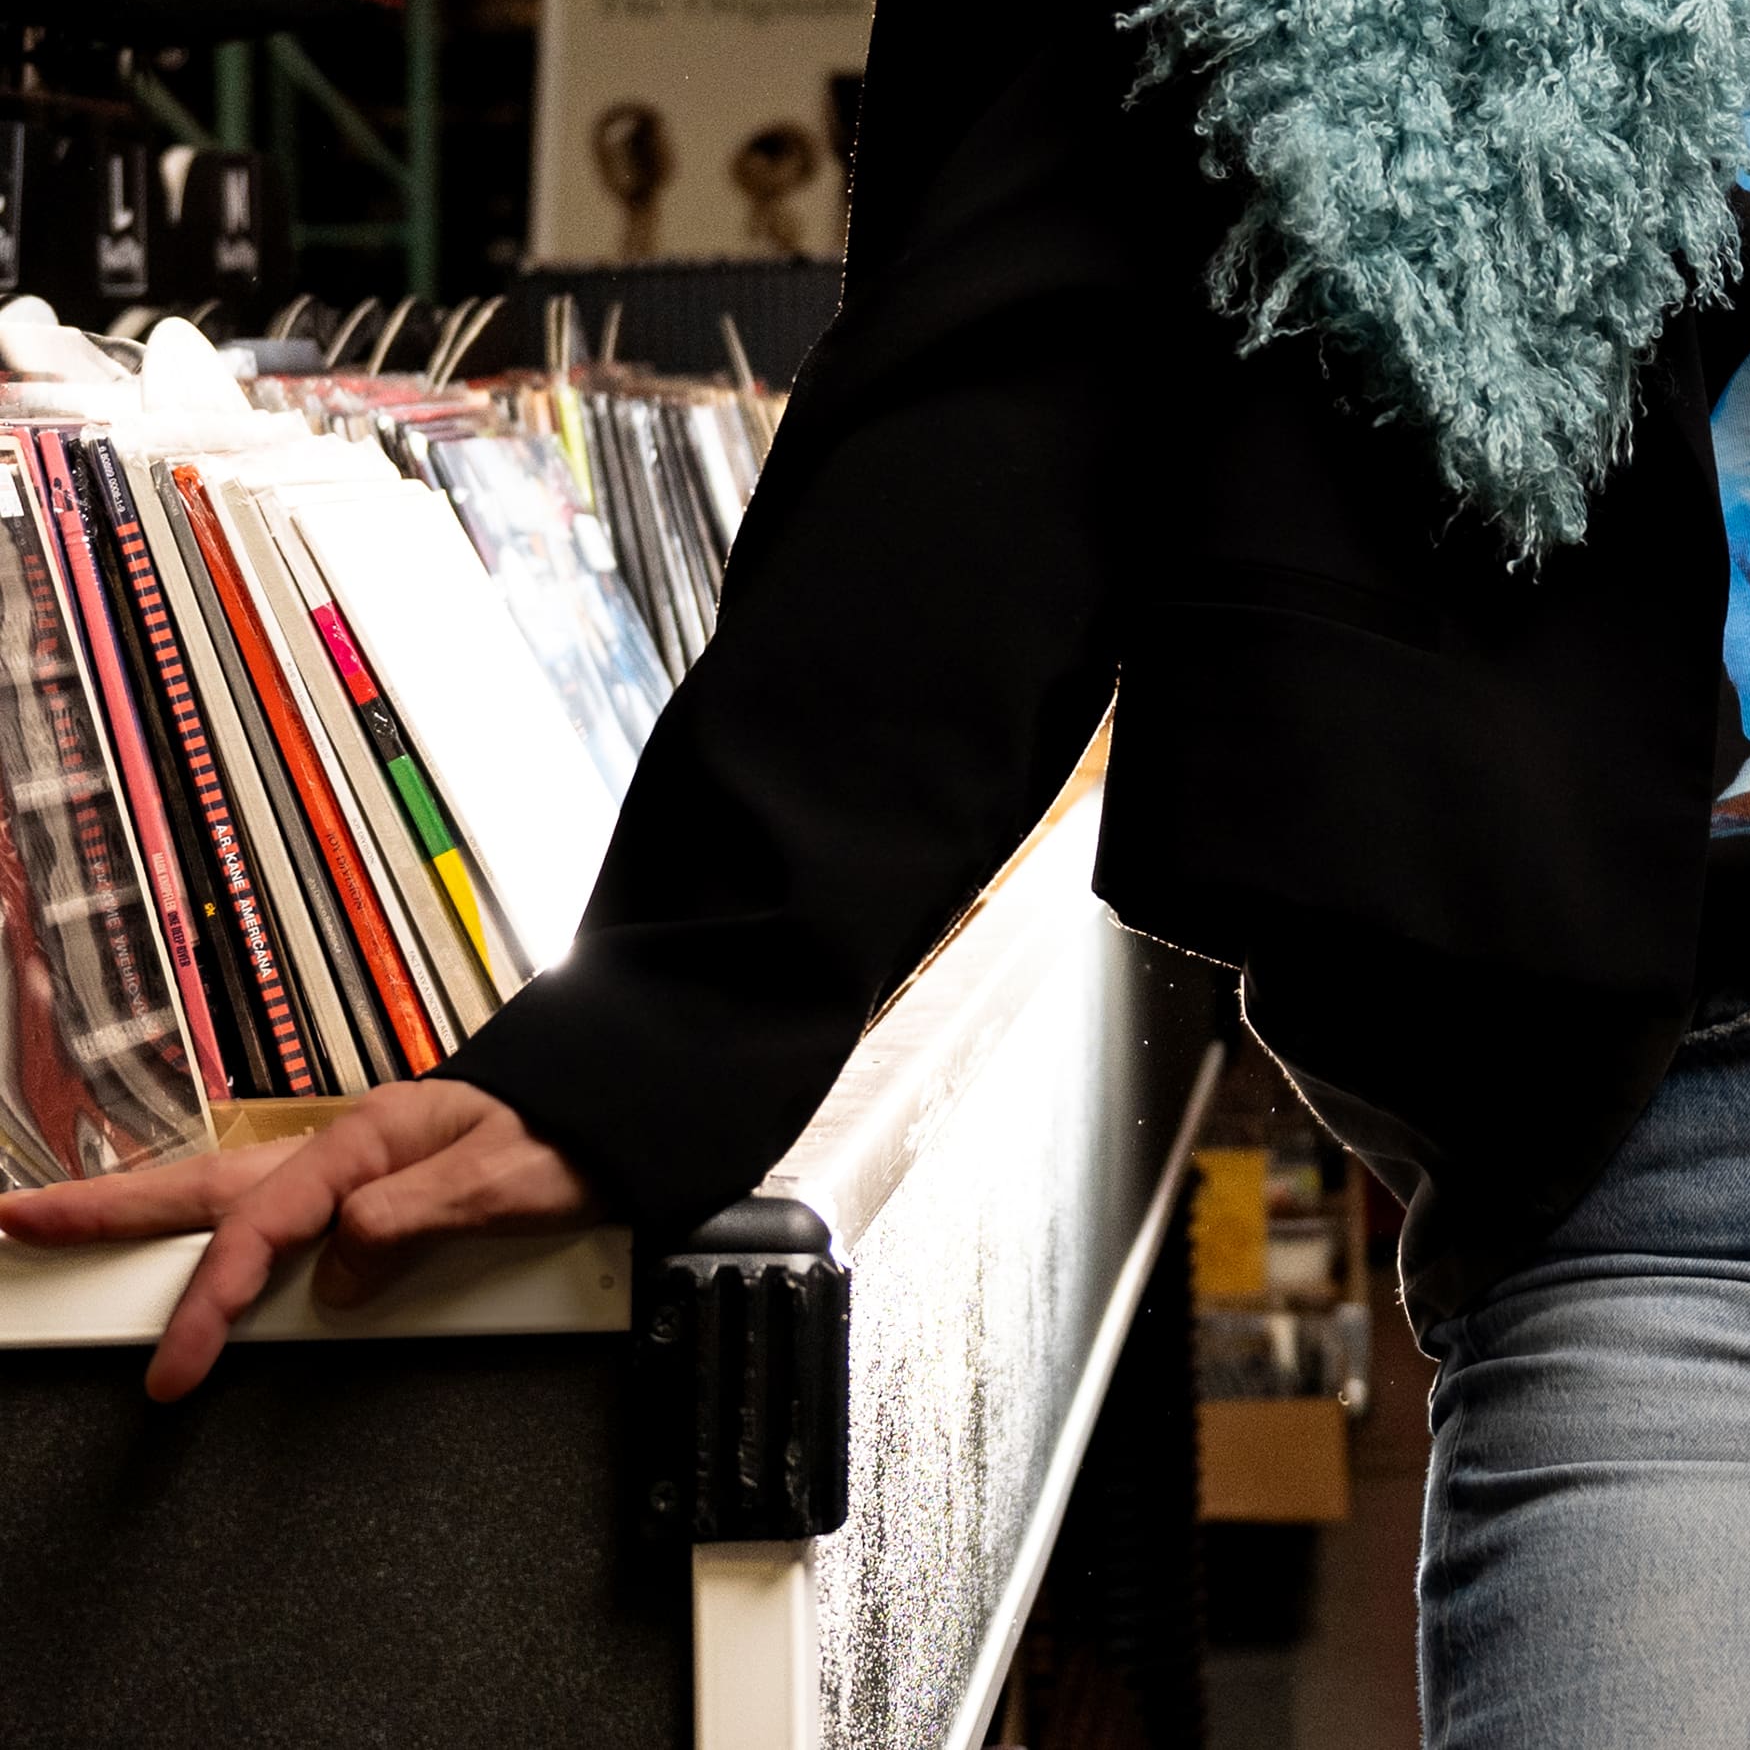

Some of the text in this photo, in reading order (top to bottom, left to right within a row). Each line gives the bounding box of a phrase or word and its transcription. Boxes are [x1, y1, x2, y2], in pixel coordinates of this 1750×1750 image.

[152, 852, 191, 968] MARK KNOPFLER ONE DEEP RIVER
[216, 825, 273, 978] A.R. KANE AMERICANA
[327, 833, 363, 911] JOY DIVISION
